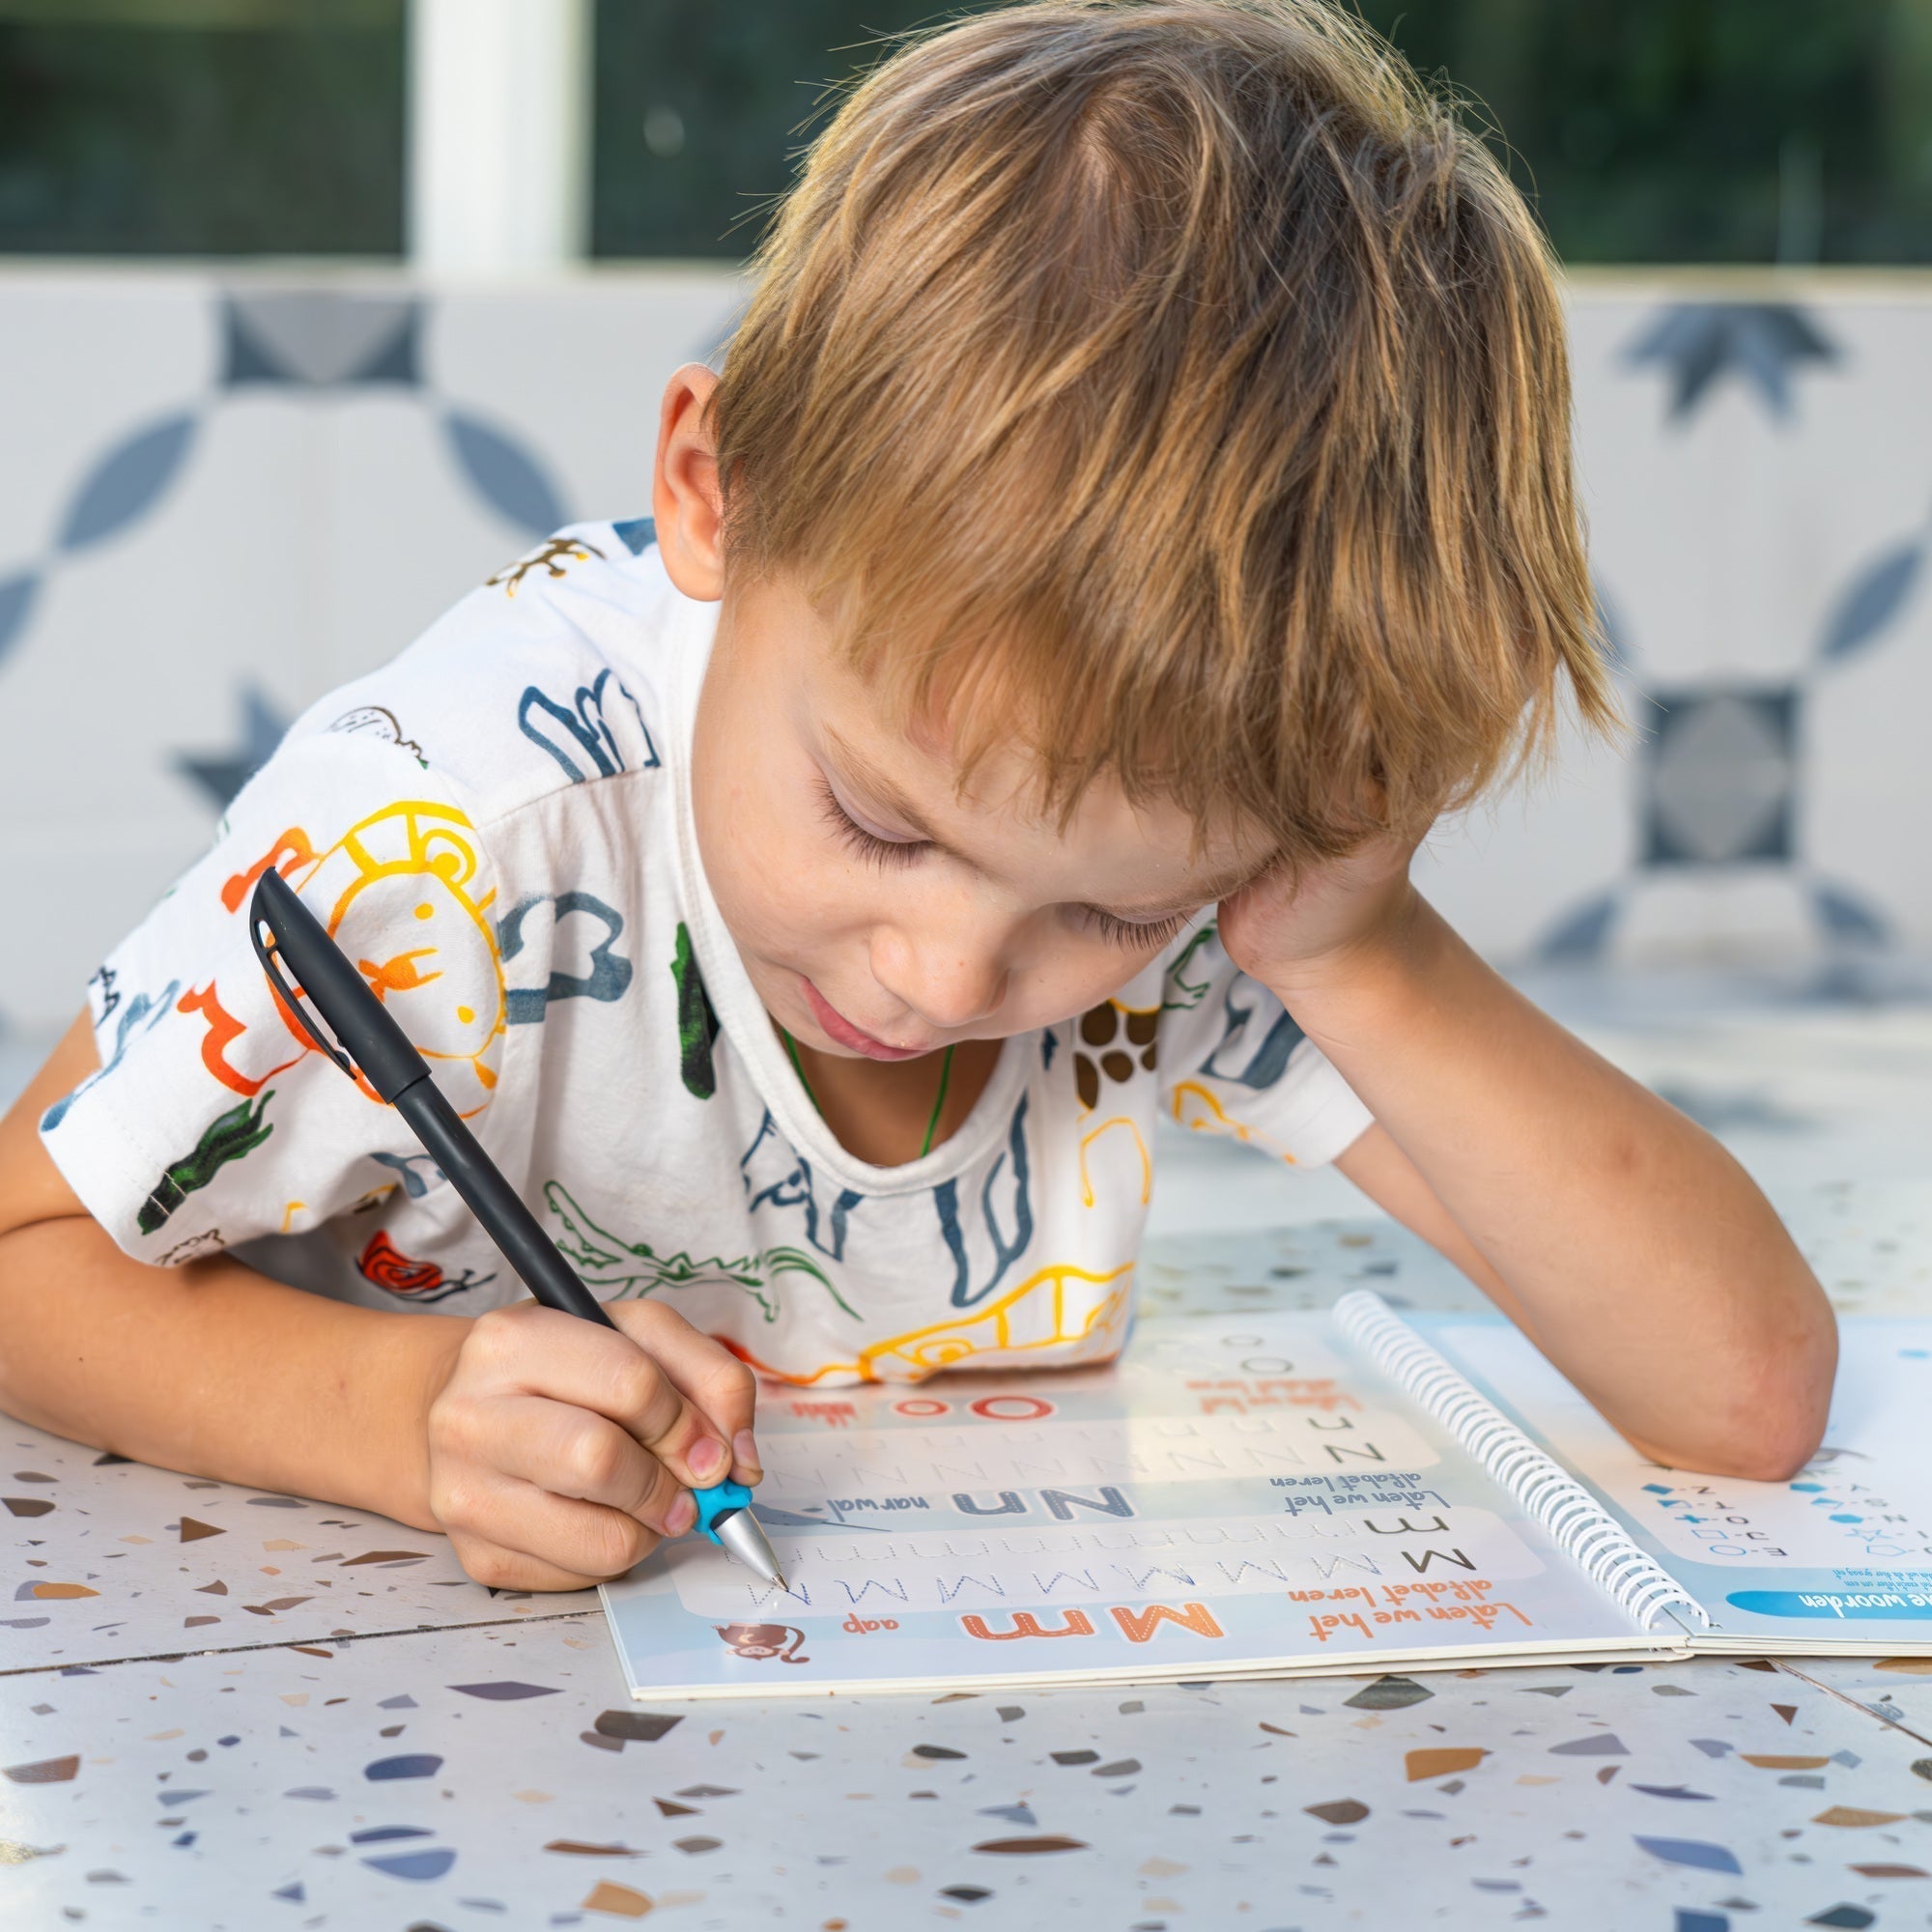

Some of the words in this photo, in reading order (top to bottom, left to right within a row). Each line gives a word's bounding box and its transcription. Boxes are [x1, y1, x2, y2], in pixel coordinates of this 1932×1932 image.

[1322, 1442, 1386, 1463] N
[1269, 1476, 1334, 1492] leren
[1338, 1472, 1422, 1491] alfabet
[827, 1496, 929, 1521] narwal
[1285, 1495, 1332, 1517] het
[1332, 1493, 1368, 1507] we
[1371, 1491, 1451, 1511] Laten
[1363, 1516, 1450, 1535] m
[1401, 1548, 1477, 1574] M
[1288, 1587, 1377, 1607] leren
[1381, 1579, 1492, 1606] alfabet
[1375, 1609, 1421, 1624] we
[1797, 1593, 1908, 1619] woorden
[842, 1613, 899, 1635] aap
[1308, 1613, 1374, 1642] het
[1425, 1603, 1533, 1631] Laten
